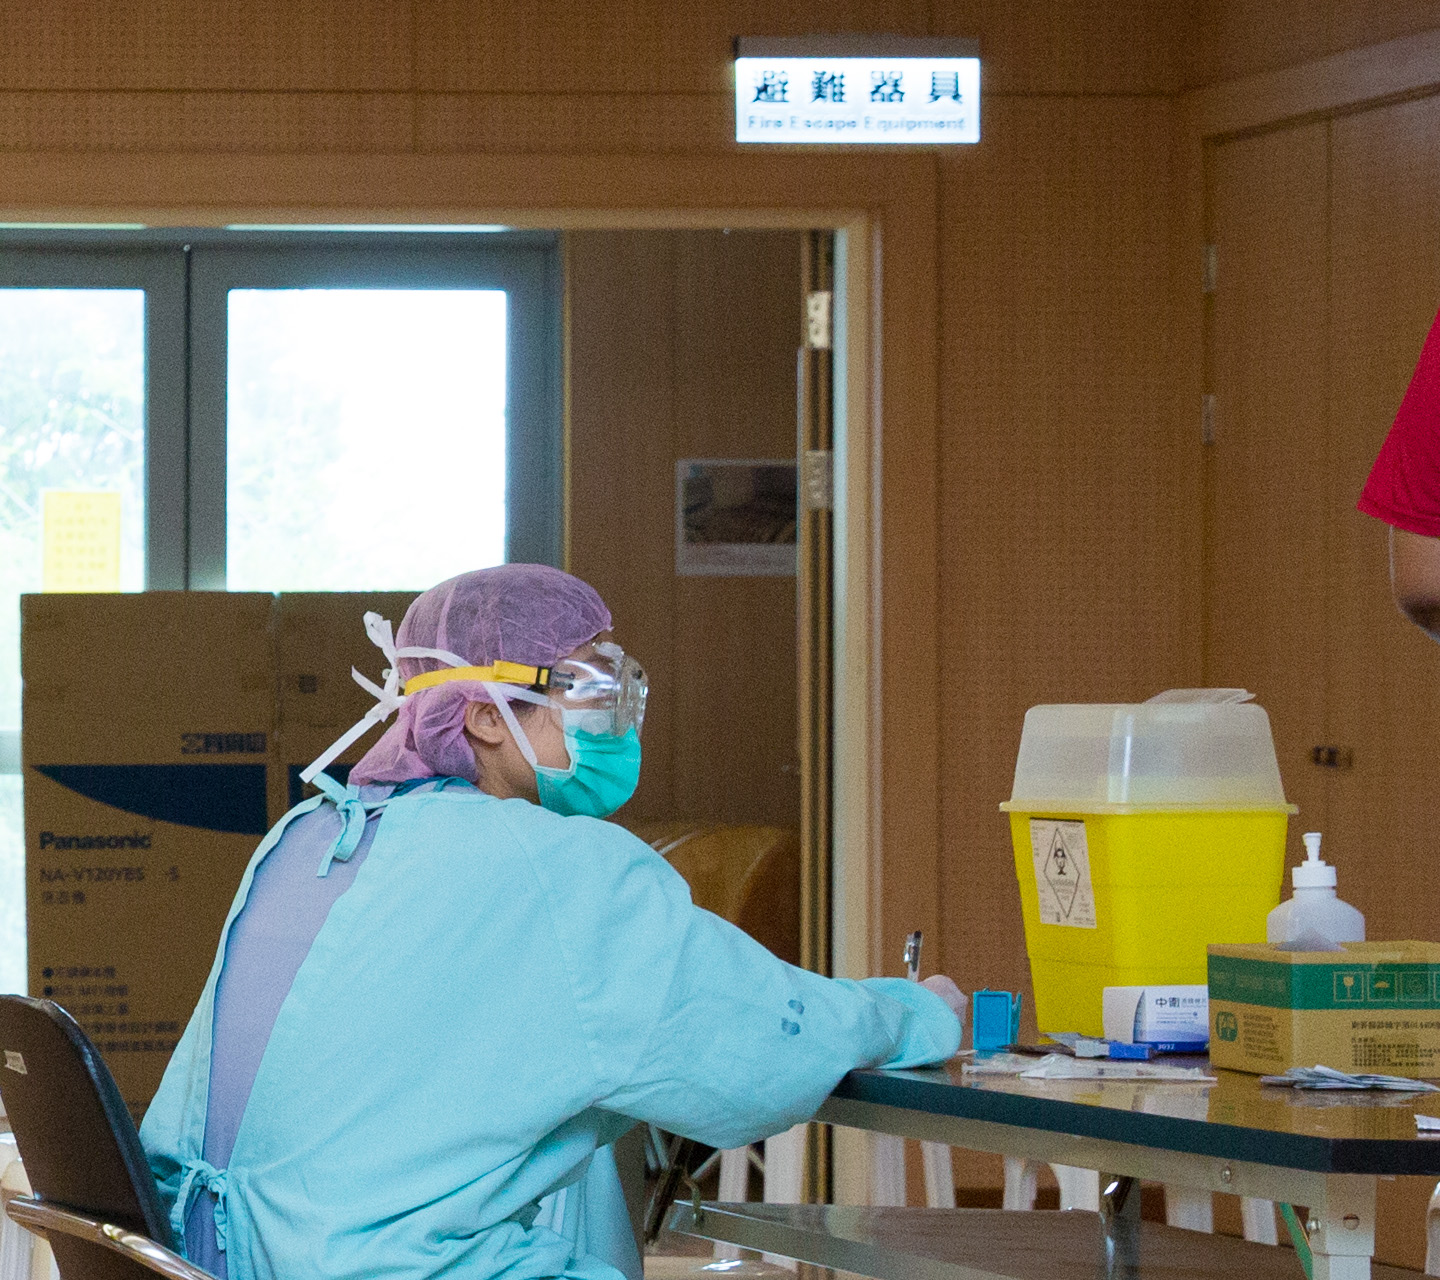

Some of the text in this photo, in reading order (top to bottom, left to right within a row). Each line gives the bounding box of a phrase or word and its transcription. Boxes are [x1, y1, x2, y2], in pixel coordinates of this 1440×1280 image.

[750, 70, 963, 104] 避難器具
[39, 830, 153, 851] Panasonic
